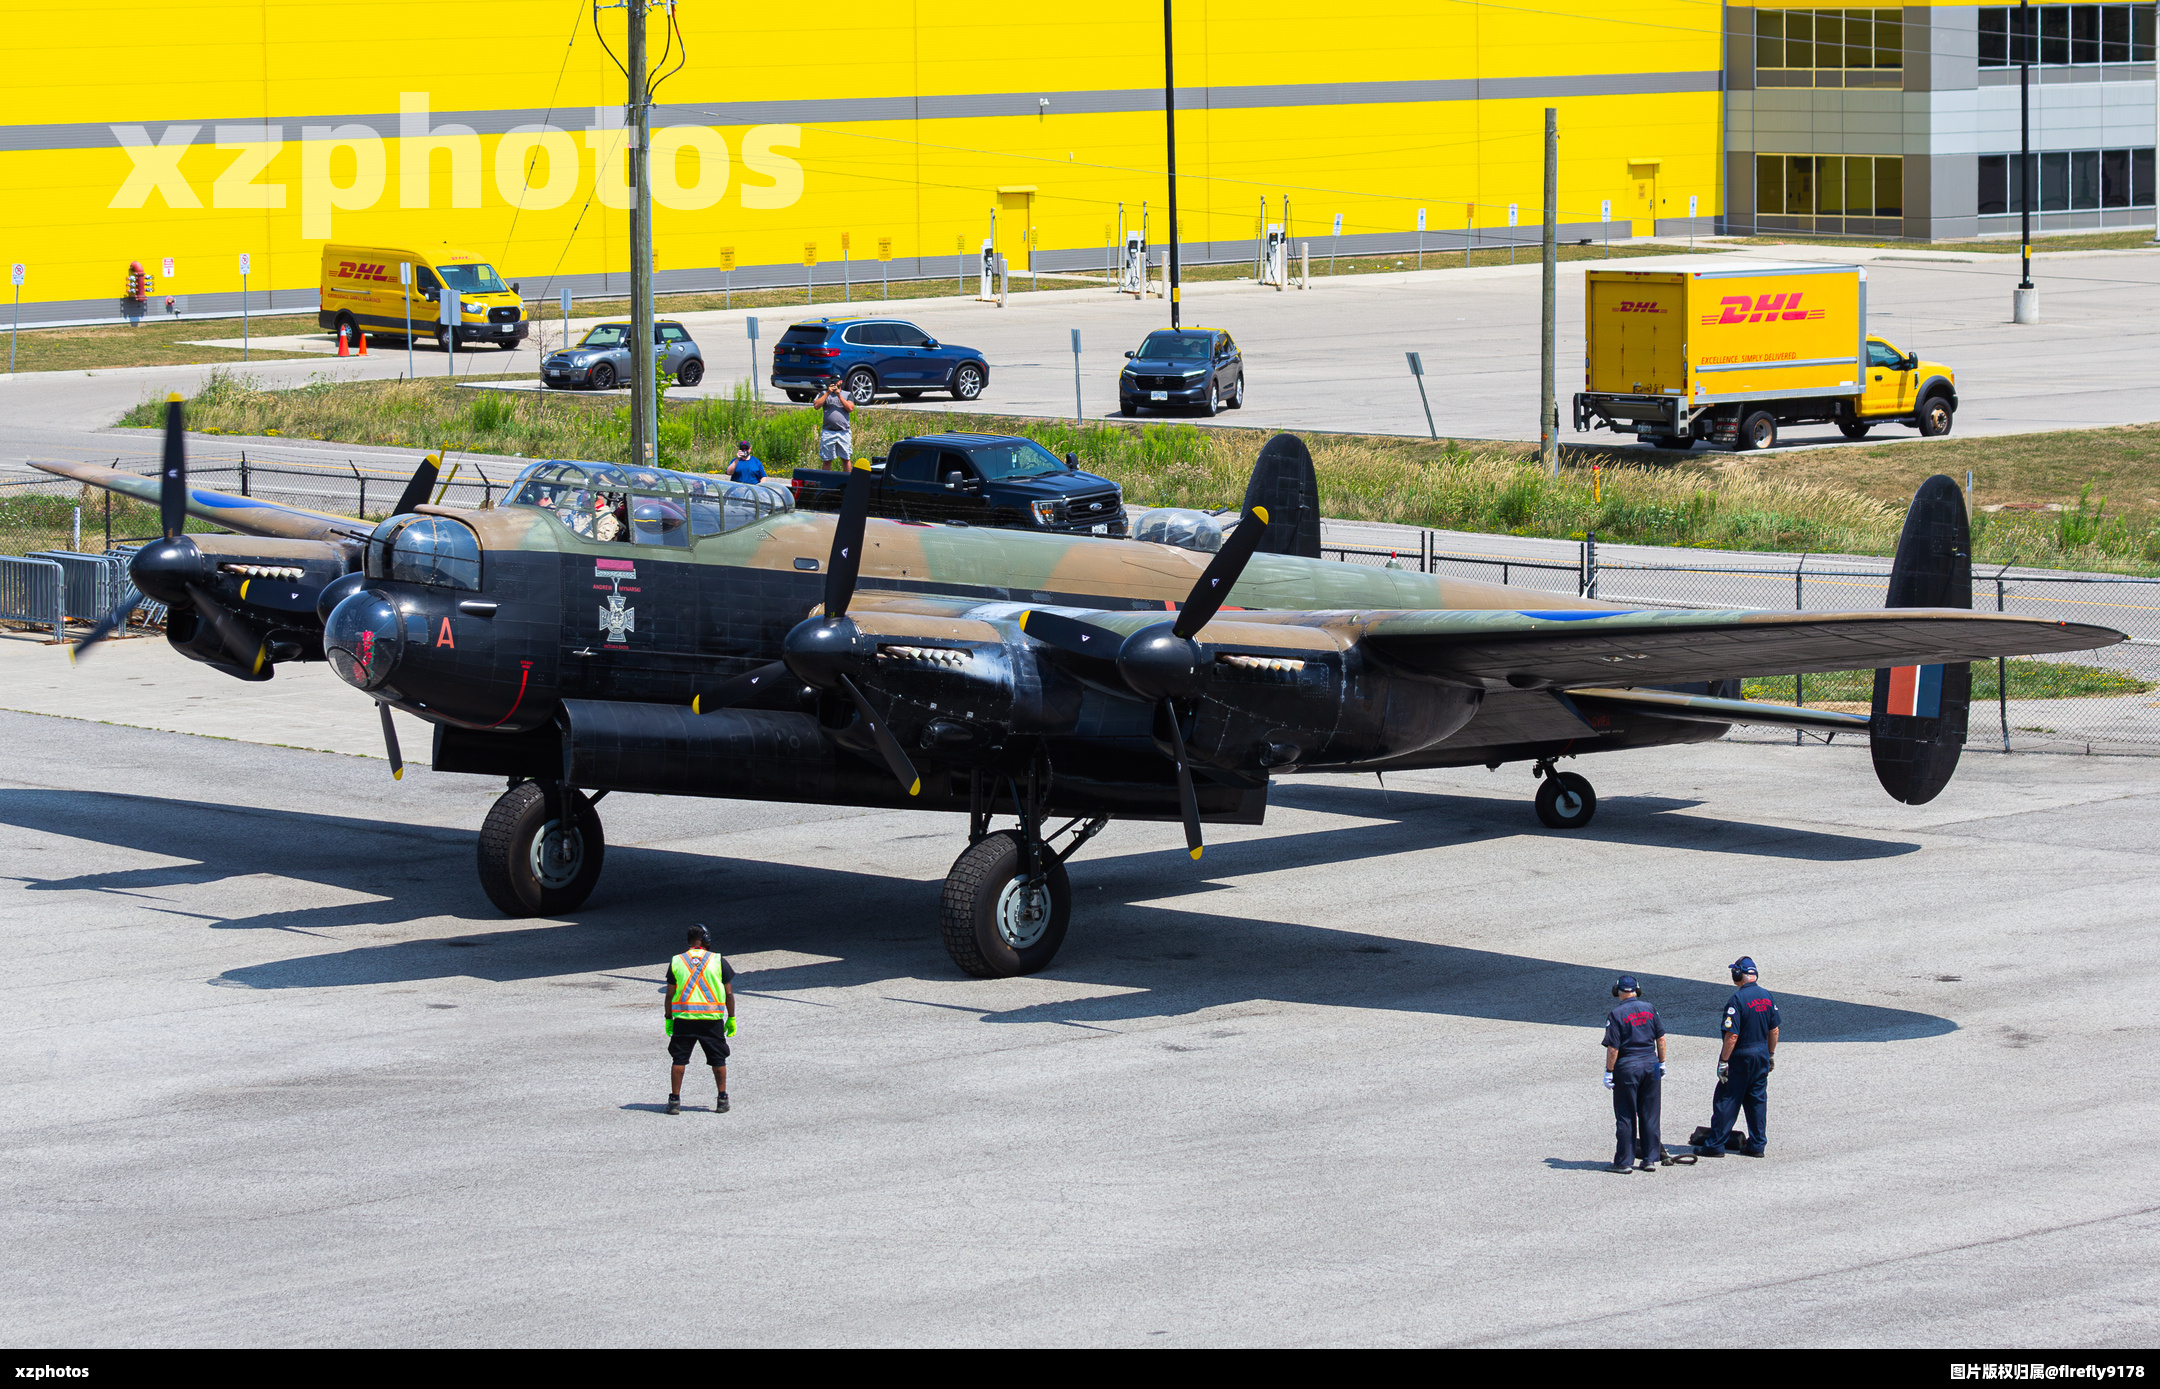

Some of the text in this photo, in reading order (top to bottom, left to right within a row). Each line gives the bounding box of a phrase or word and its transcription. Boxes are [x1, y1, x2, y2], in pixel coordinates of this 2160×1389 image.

[337, 261, 389, 283] DHL
[1619, 301, 1661, 313] DHL
[1717, 292, 1810, 325] DHL
[1700, 355, 1740, 365] EXCELLENCE.
[1741, 353, 1763, 363] SIMPLY
[436, 616, 455, 649] A
[1747, 998, 1772, 1009] LANCASTER
[1754, 1004, 1768, 1013] CREW
[1622, 1010, 1654, 1024] LANCASTER
[1631, 1018, 1647, 1027] CREW
